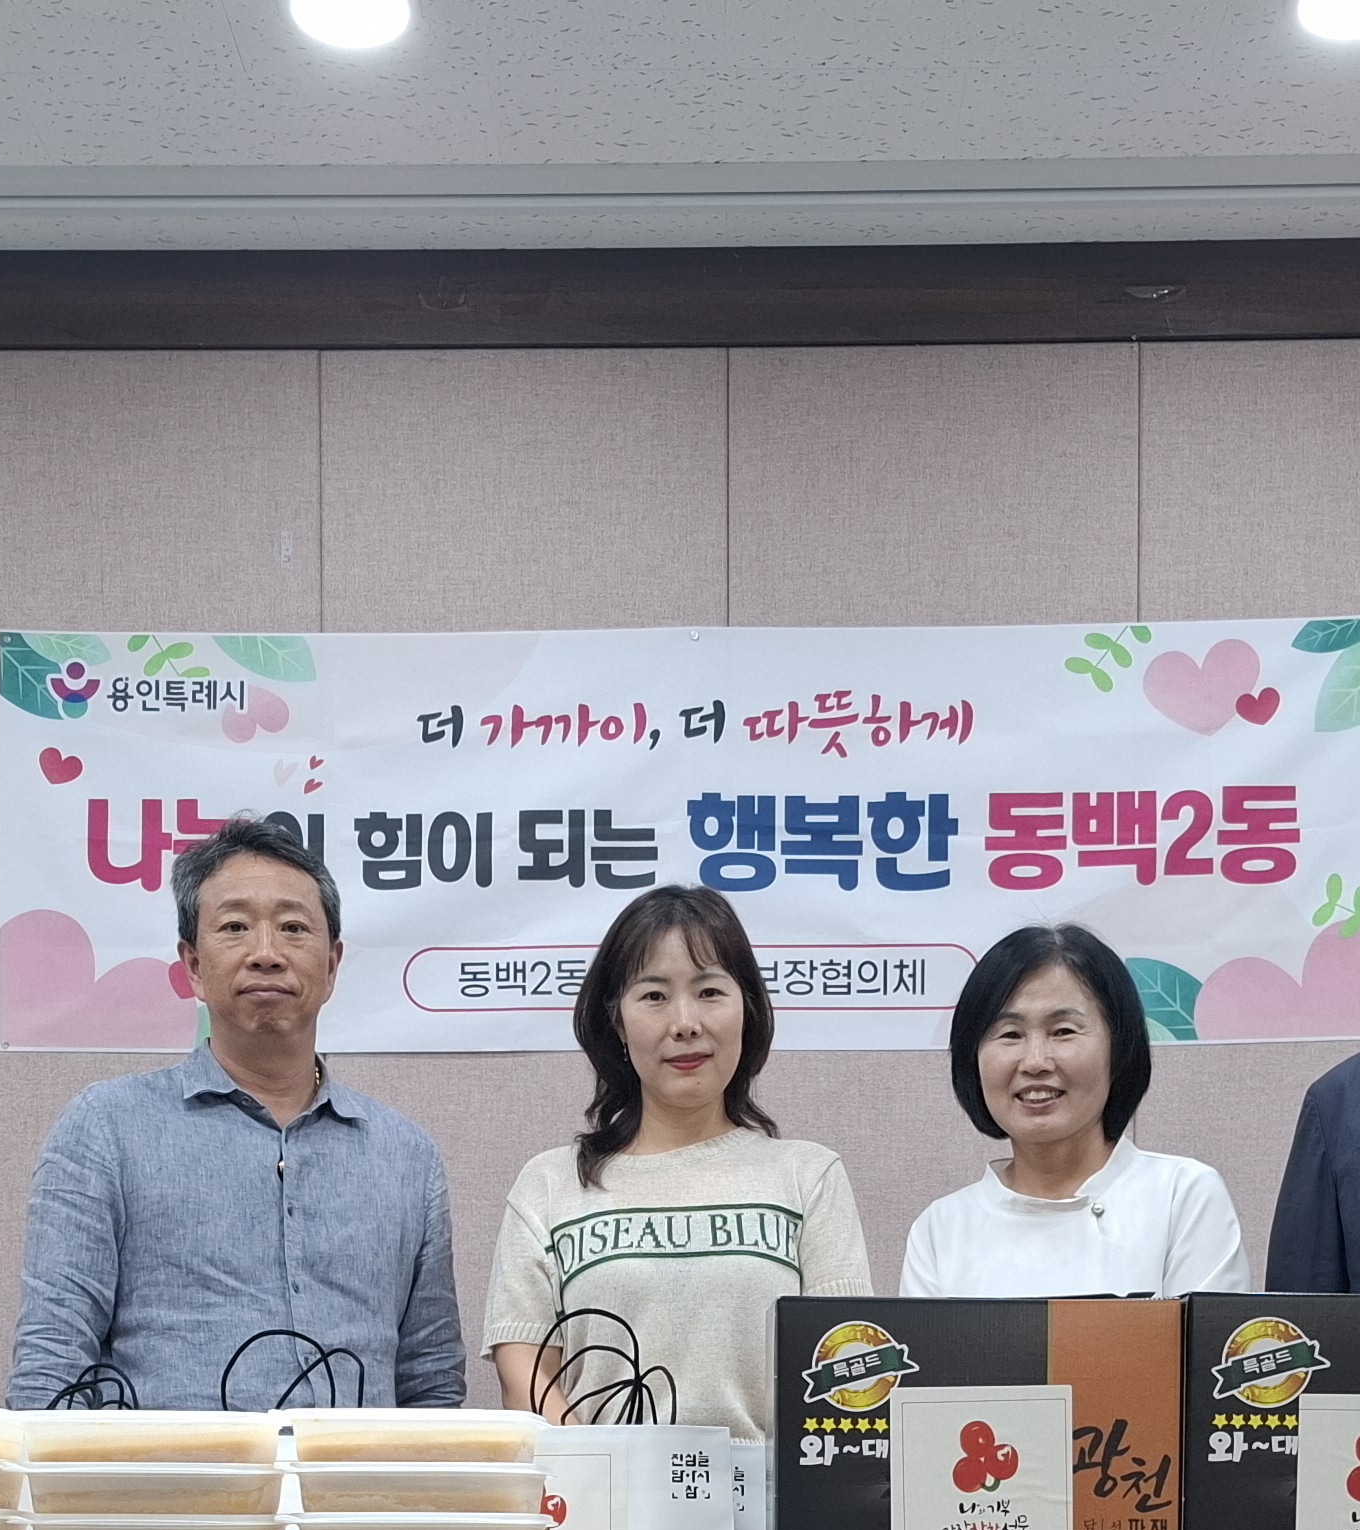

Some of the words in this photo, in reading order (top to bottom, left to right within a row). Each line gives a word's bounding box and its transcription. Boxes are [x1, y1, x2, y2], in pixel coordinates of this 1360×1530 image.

[108, 677, 247, 712] 용인특례시
[418, 704, 464, 747] 더
[481, 702, 661, 750] 가까이,
[680, 699, 726, 743] 더
[743, 689, 975, 759] 따뜻하게
[354, 810, 494, 891] 힘이
[518, 808, 659, 888] 되는
[686, 791, 959, 892] 행복한
[984, 784, 1301, 891] 동백2동
[458, 959, 588, 997] 동백2동
[556, 1215, 692, 1274] OISEAU
[708, 1212, 800, 1263] BLUE
[671, 1450, 710, 1467] 진심을
[1072, 1418, 1172, 1512] 광천
